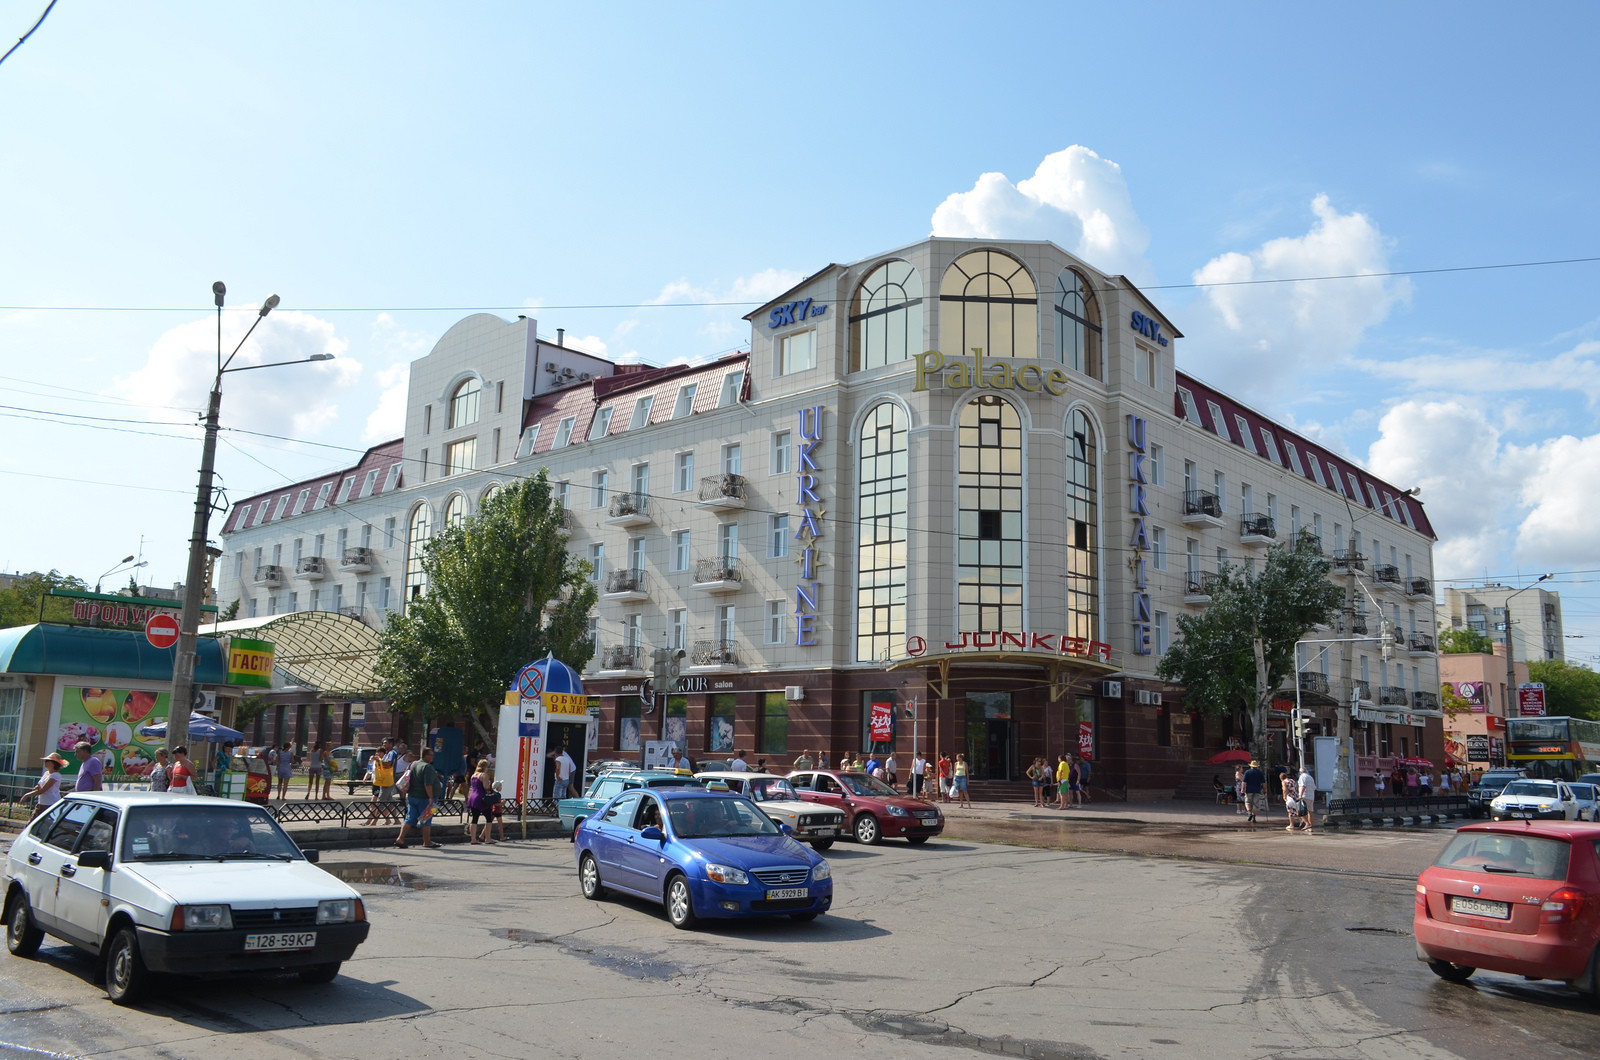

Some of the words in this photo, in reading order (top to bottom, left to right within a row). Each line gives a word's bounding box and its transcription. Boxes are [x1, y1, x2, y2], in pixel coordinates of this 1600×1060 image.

[768, 297, 812, 329] SKY
[810, 304, 827, 317] bar
[1131, 311, 1160, 341] SKY
[912, 347, 1069, 396] Palace
[795, 405, 823, 645] UKRAINE
[1126, 414, 1151, 655] UKRAINE
[73, 601, 181, 625] ПРОДУК
[944, 631, 1112, 660] JUNKER
[621, 684, 638, 692] salon
[640, 678, 708, 714] GOUR
[714, 681, 734, 689] salon
[782, 889, 796, 897] 5929
